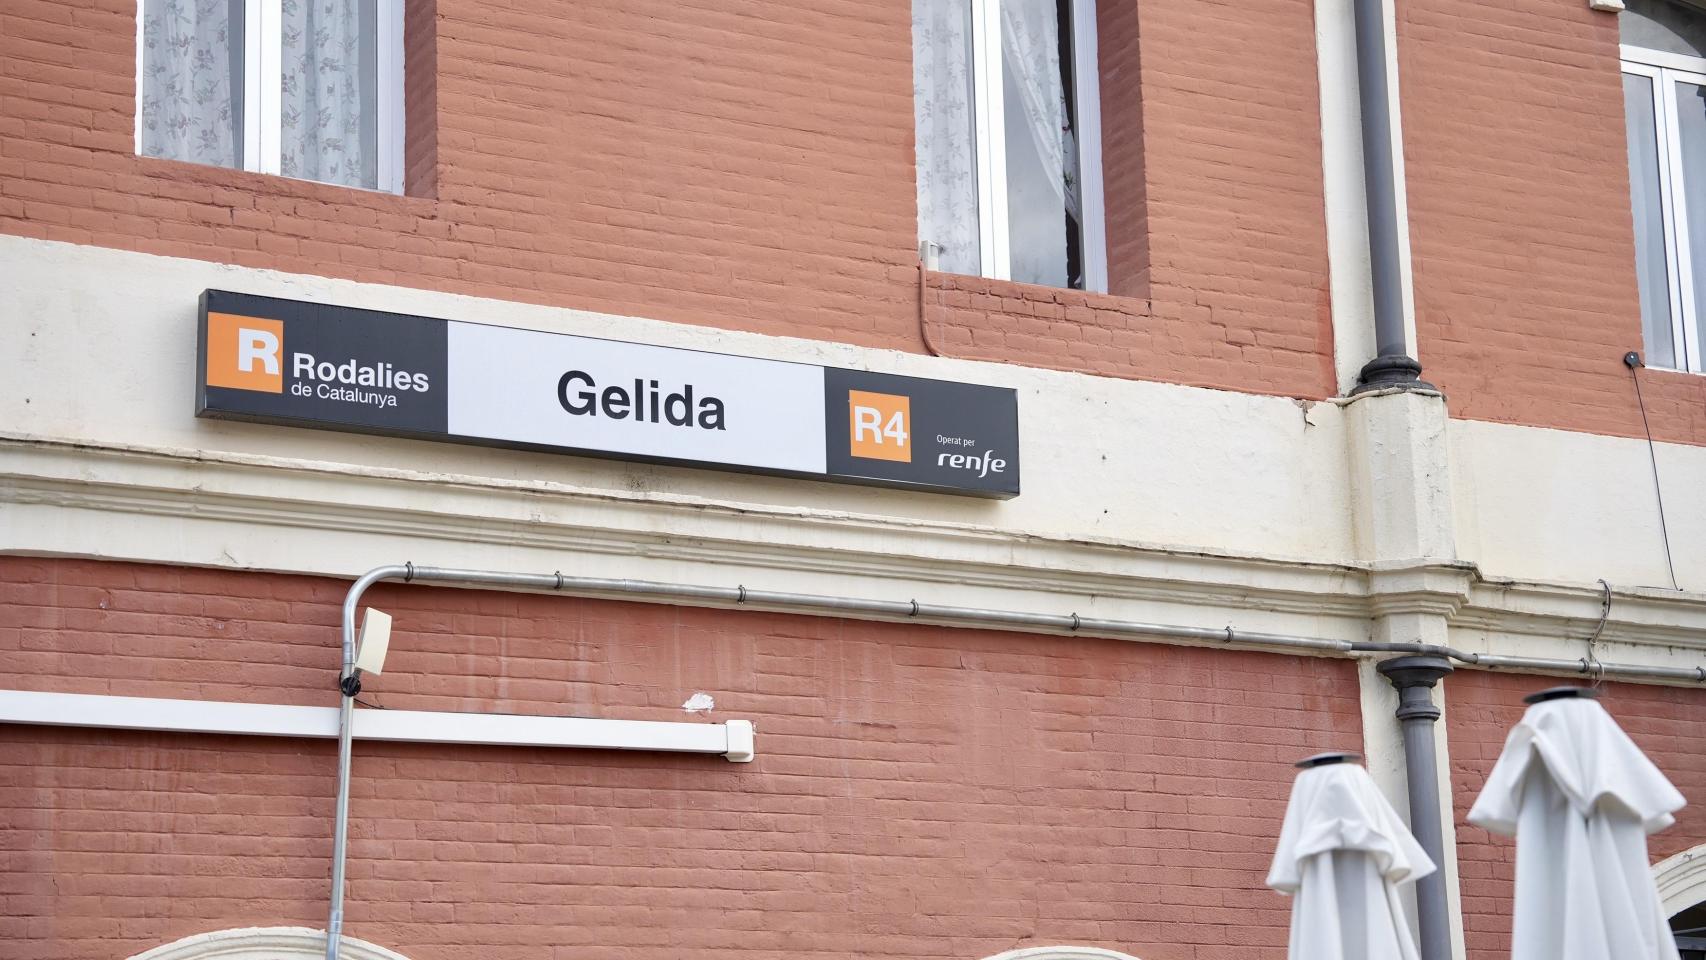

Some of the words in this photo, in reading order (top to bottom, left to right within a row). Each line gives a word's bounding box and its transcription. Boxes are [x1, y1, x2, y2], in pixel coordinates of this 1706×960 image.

[238, 328, 280, 375] R
[292, 352, 430, 393] Rodalies
[291, 381, 312, 397] de
[317, 384, 398, 408] Catalunya
[557, 370, 726, 431] Gelida
[853, 405, 908, 447] R4
[936, 434, 961, 446] Operat
[963, 438, 975, 447] per
[937, 449, 1007, 478] renfe
